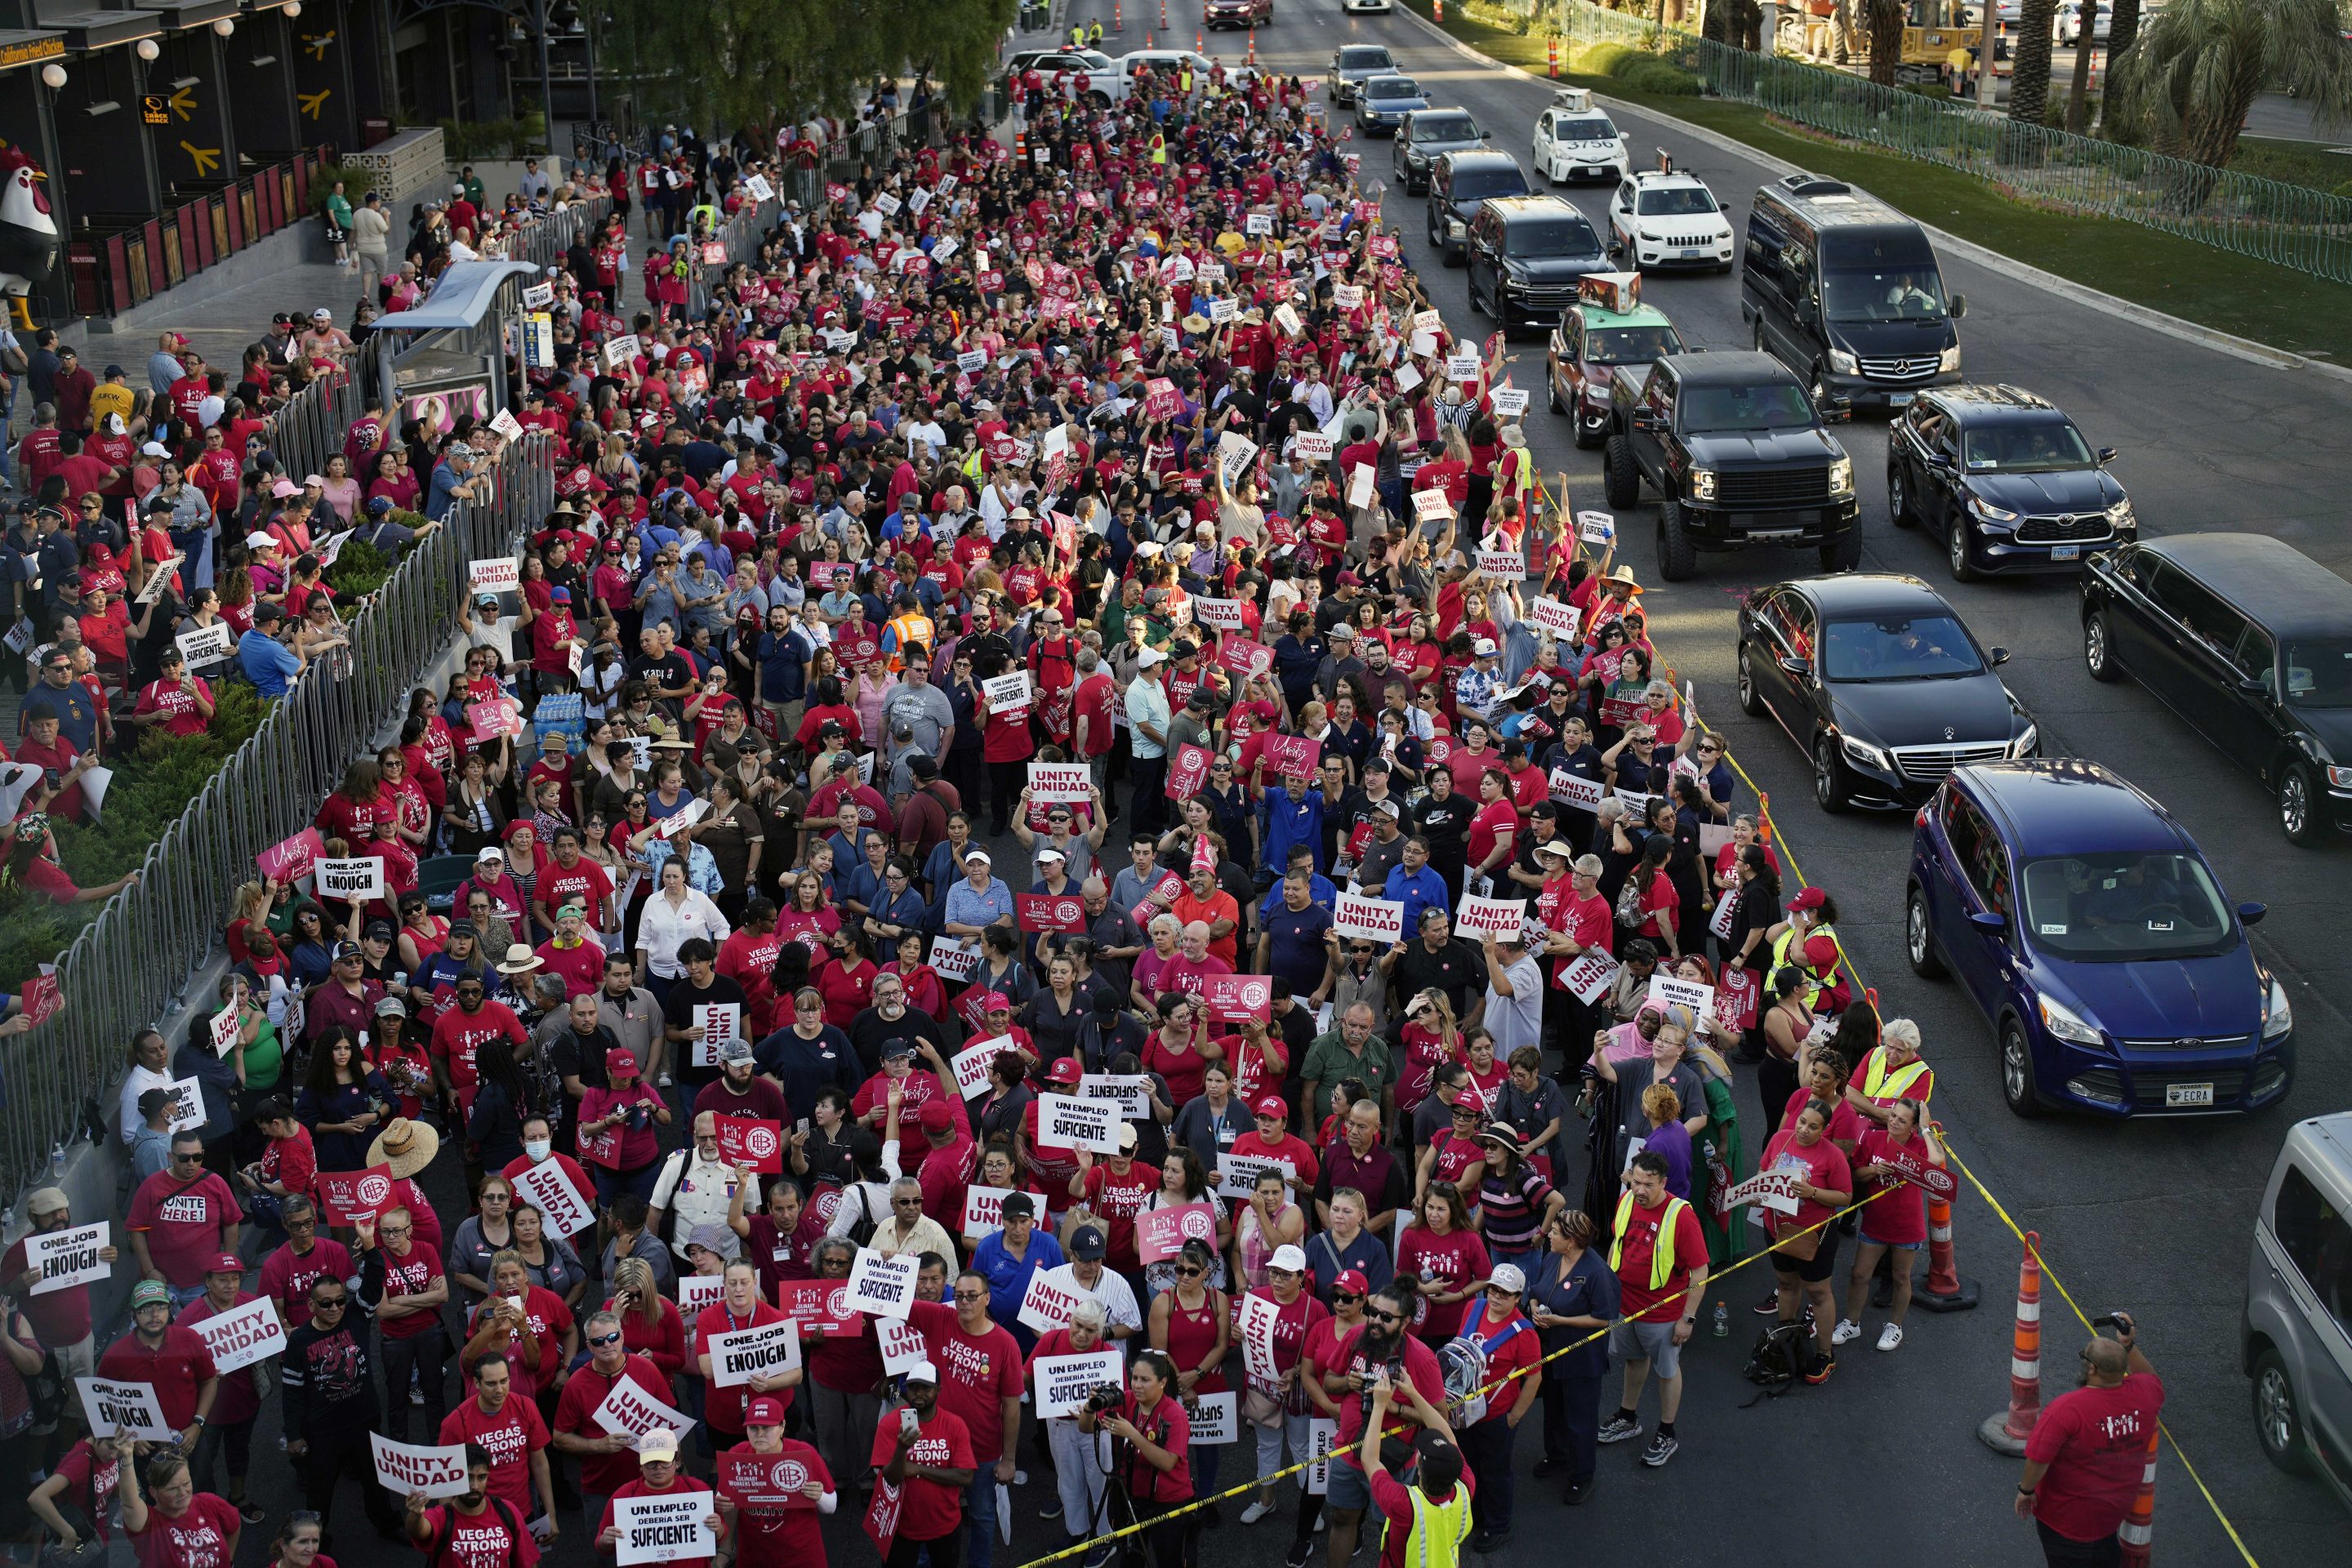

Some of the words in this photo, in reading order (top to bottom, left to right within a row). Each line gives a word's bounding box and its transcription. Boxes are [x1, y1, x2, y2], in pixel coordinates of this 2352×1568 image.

[1926, 35, 1941, 44] CAT
[1, 44, 29, 65] California
[29, 41, 43, 58] Fried
[42, 38, 65, 55] Chicken
[1567, 139, 1614, 150] 3756
[1335, 293, 1361, 302] UNIDAD
[1340, 287, 1361, 295] UNITY
[1216, 310, 1235, 318] SUFICIENTE
[1416, 320, 1437, 328] UNIDAD
[1454, 368, 1476, 376] SUFICIENTE
[98, 392, 119, 400] UFCW
[1499, 400, 1522, 410] SUFICIENTE
[1301, 436, 1328, 445] UNITY
[102, 443, 127, 453] TAPOUT
[1297, 443, 1331, 453] UNIDAD
[1482, 556, 1519, 565] UNITY
[476, 564, 513, 575] UNITY
[1479, 564, 1524, 572] UNIDAD
[146, 566, 170, 595] SUFICIENTE
[472, 573, 518, 583] UNIDAD
[1200, 603, 1235, 612] UNITY
[1538, 604, 1574, 621] UNITY
[1198, 609, 1240, 621] UNIDAD
[1534, 612, 1575, 630] UNIDAD
[197, 630, 220, 641] EMPLEO
[187, 643, 221, 662] SUFICIENTE
[1002, 676, 1022, 684] EMPLEO
[1174, 680, 1196, 688] VEGAS
[995, 688, 1024, 704] SUFICIENTE
[894, 703, 924, 715] CHAMPIONS
[1273, 737, 1307, 758] Unity
[1035, 770, 1082, 781] UNITY
[1275, 761, 1310, 778] Unidad
[1031, 782, 1088, 791] UNIDAD
[1556, 777, 1597, 795] UNITY
[1554, 786, 1600, 804] NIDAD
[327, 875, 372, 889] ENOUGH
[556, 877, 586, 886] VEGAS
[1344, 902, 1394, 919] UNITY
[1470, 906, 1519, 919] UNITY
[1337, 913, 1399, 931] UNIDAD
[1461, 915, 1520, 930] UNIDAD
[749, 947, 777, 958] VEGAS
[1571, 952, 1608, 983] UNITY
[1575, 963, 1619, 995] UNIDAD
[1676, 985, 1704, 997] EMPLEO
[706, 1007, 718, 1064] UNIDAD
[1089, 1085, 1148, 1099] SUFICIENTE
[2184, 1091, 2207, 1102] ECRA
[1056, 1102, 1071, 1111] UN
[1072, 1105, 1108, 1116] EMPLEO
[1060, 1111, 1087, 1120] DEBERÍA
[1129, 1108, 1147, 1116] UN
[1054, 1120, 1106, 1141] SUFICIENTE
[1106, 1186, 1141, 1194] VEGAS
[1735, 1174, 1792, 1194] UNITY
[541, 1171, 581, 1221] UNITY
[1102, 1194, 1145, 1203] STRONG
[166, 1197, 204, 1209] UNITE
[526, 1171, 573, 1235] UNIDAD
[162, 1207, 203, 1221] HERE!
[41, 1237, 70, 1250] ONE
[71, 1231, 97, 1243] JOB
[54, 1245, 75, 1254] SHOULD
[43, 1250, 97, 1279] ENOUGH
[867, 1258, 882, 1267] UN
[882, 1262, 909, 1273] EMPLEO
[869, 1271, 890, 1279] DEBERÍA
[892, 1274, 902, 1282] SER
[858, 1279, 903, 1303] SUFICIENTE
[1036, 1281, 1080, 1307] UNITY
[1026, 1294, 1071, 1323] UNIDA
[201, 1310, 265, 1346] UNITY
[723, 1335, 754, 1348] ONE
[755, 1327, 785, 1342] JOB
[1248, 1301, 1263, 1374] UNIDAD
[1256, 1313, 1271, 1374] UNITY
[737, 1343, 763, 1352] SHOULD
[726, 1343, 786, 1374] ENOUGH
[1049, 1365, 1064, 1374] UN
[1067, 1361, 1106, 1372] EMPLEO
[1055, 1374, 1085, 1383] DEBERÍA
[91, 1383, 113, 1395] ONE
[115, 1388, 143, 1398] JOB
[106, 1396, 122, 1404] SHOULD
[98, 1401, 153, 1428] ENOUGH
[620, 1392, 681, 1429] UNITY
[475, 1425, 522, 1445] VEGAS
[382, 1447, 454, 1470] UNITY
[377, 1460, 464, 1486] UNIDAD
[1317, 1467, 1325, 1483] UN
[630, 1506, 648, 1515] UN
[653, 1503, 697, 1513] EMPLEO
[638, 1516, 673, 1525] DEBERÍA
[457, 1527, 504, 1539] VEGAS
[631, 1525, 697, 1548] SUFICIENTE
[452, 1539, 509, 1552] STRONG
[1087, 1534, 1118, 1549] CAUTION
